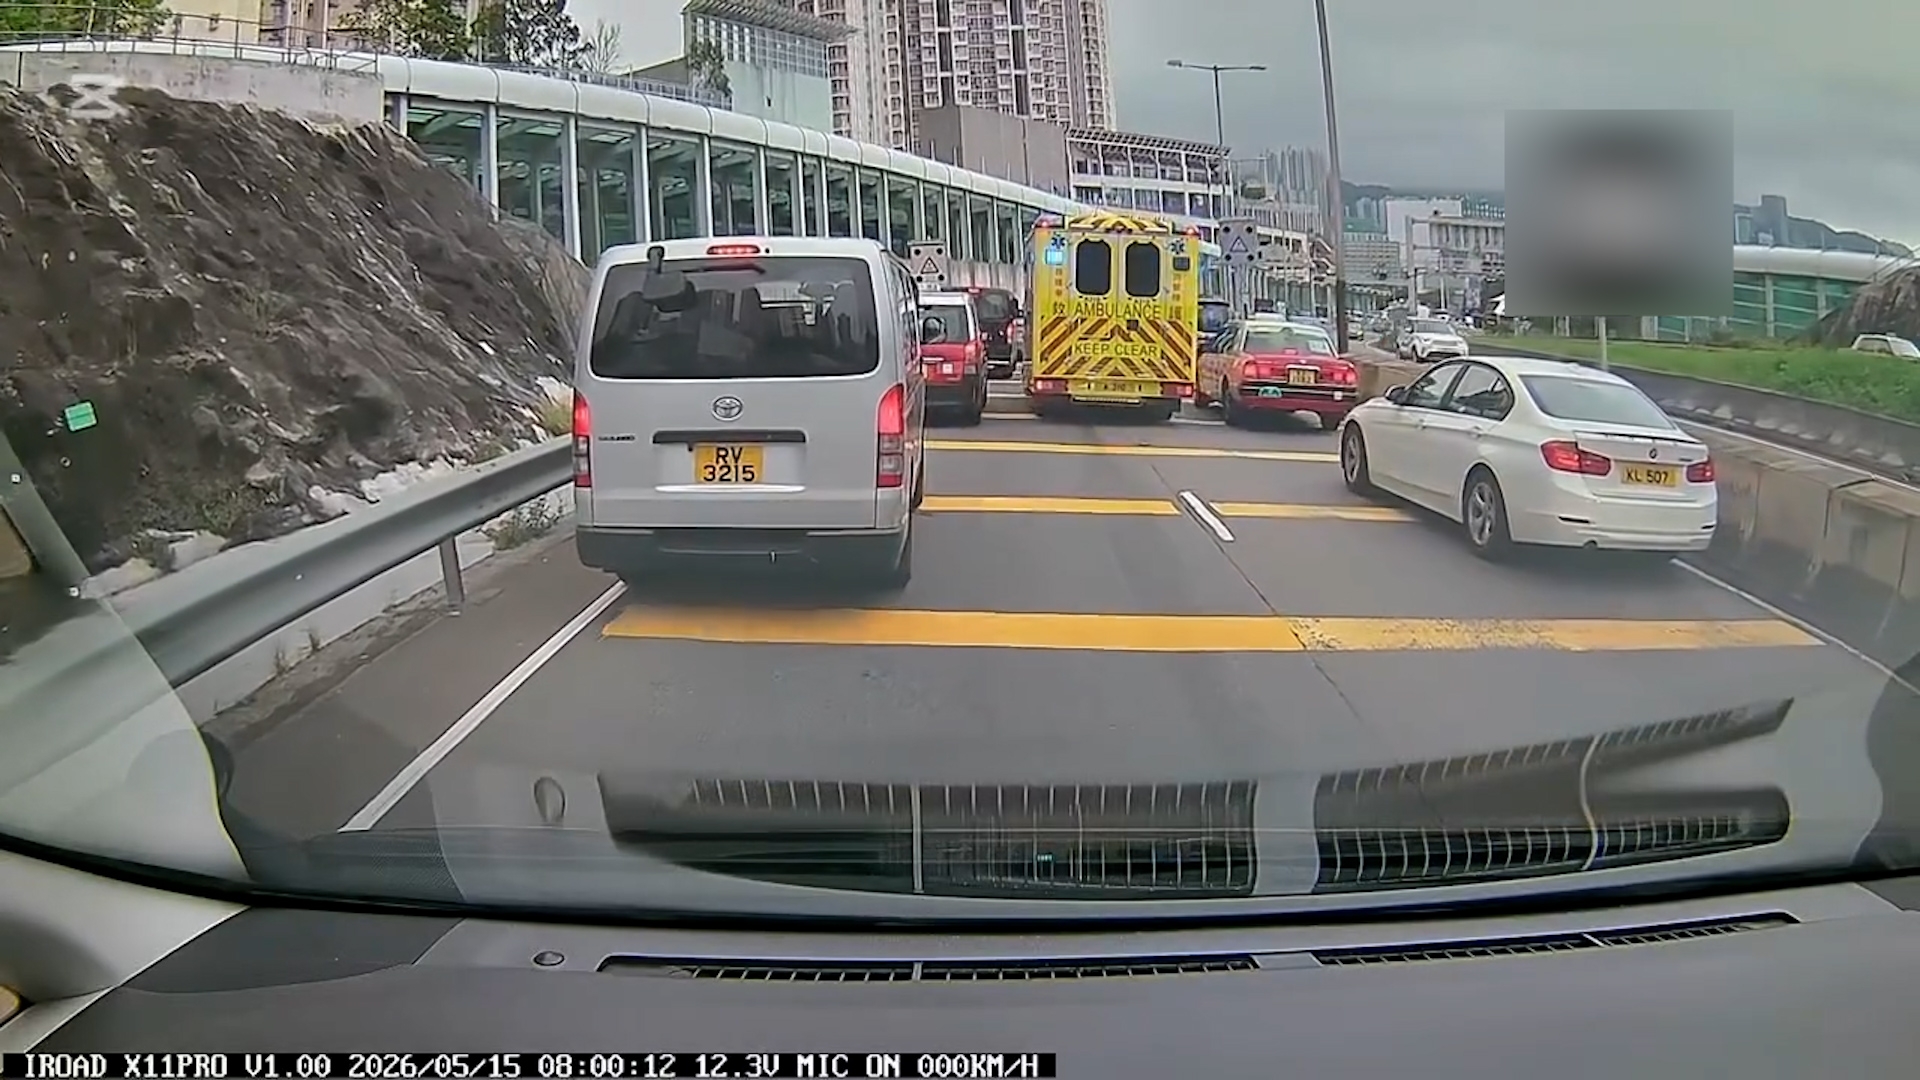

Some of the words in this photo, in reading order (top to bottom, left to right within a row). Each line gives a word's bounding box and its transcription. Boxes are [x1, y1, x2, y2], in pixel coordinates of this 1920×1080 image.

[1074, 302, 1161, 320] AMBULANCE
[1074, 343, 1110, 356] KEEP
[1114, 344, 1157, 358] CLEAR
[715, 447, 743, 465] RV
[703, 465, 755, 482] 3215
[1646, 469, 1668, 483] 507
